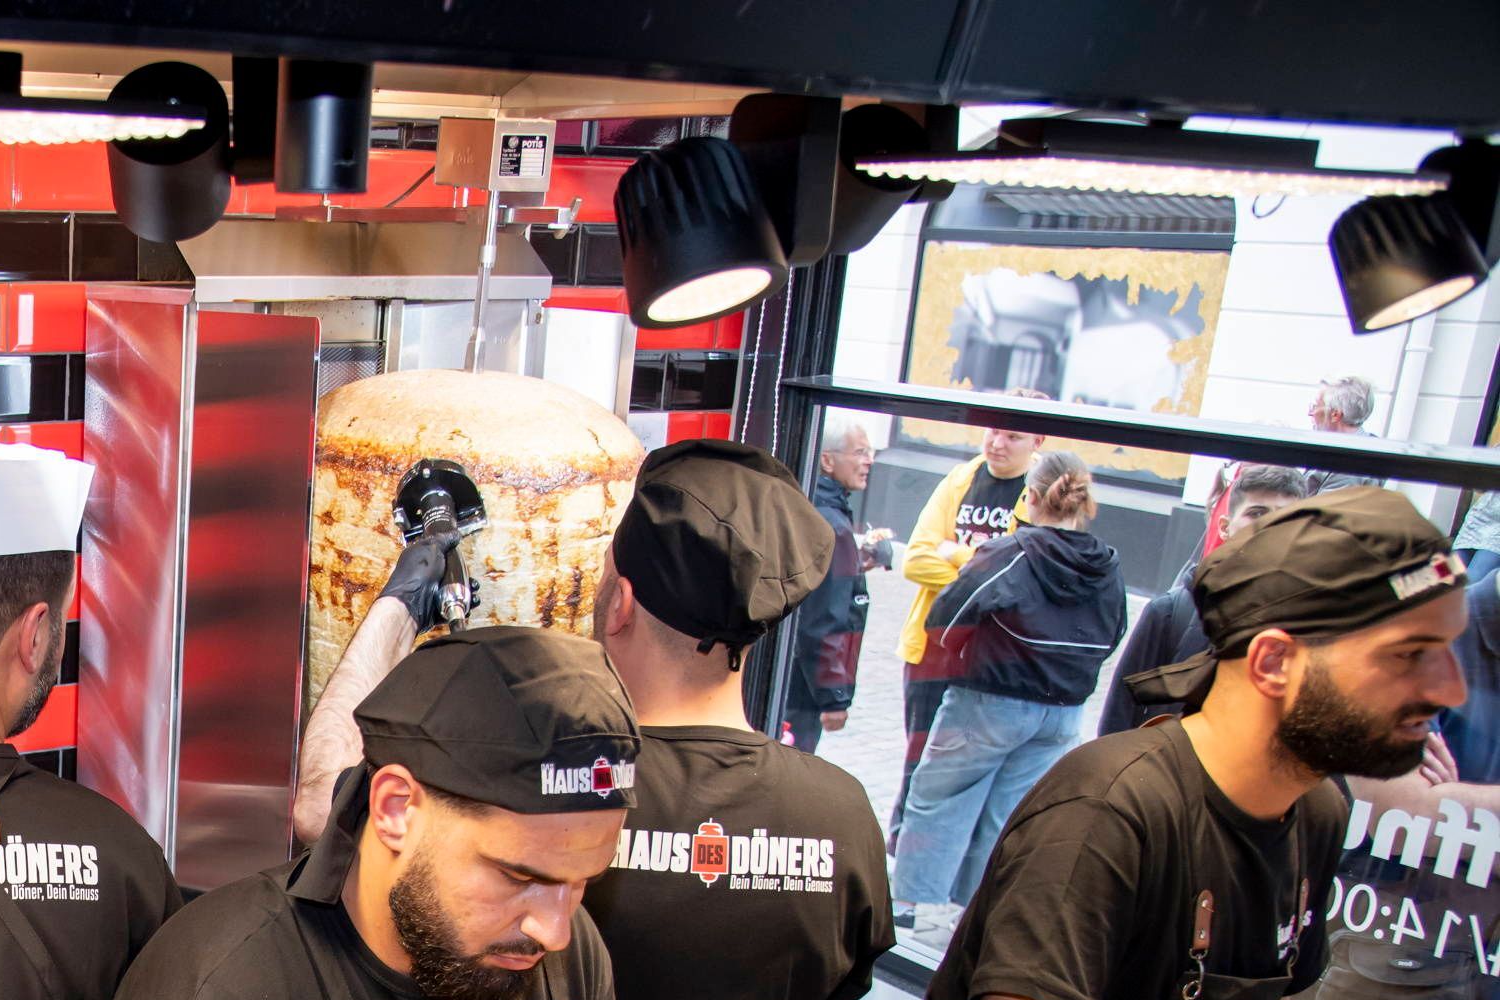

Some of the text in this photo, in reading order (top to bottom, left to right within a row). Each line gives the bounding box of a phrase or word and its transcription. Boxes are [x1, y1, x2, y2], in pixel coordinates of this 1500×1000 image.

[541, 764, 591, 794] HAUS
[609, 829, 834, 878] HAUS DES DÖNERS
[11, 884, 99, 901] Döner, Dein Genuss
[729, 874, 833, 893] Dein Döner, Dein Genuss
